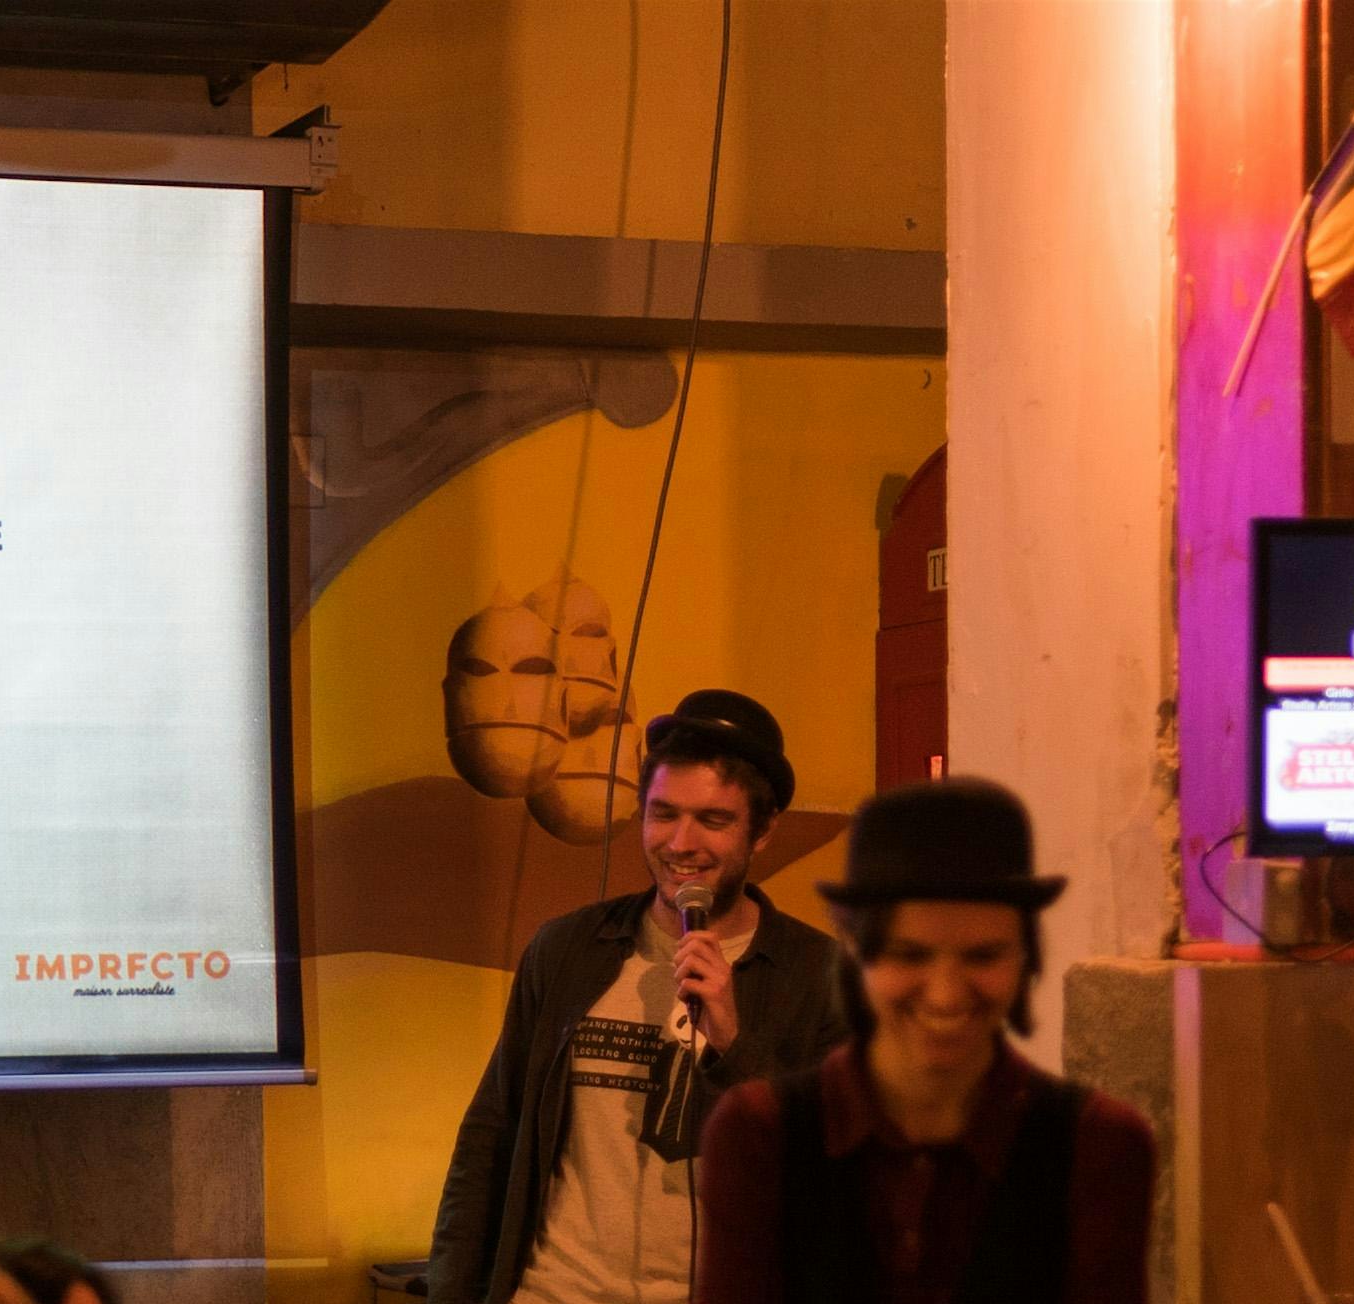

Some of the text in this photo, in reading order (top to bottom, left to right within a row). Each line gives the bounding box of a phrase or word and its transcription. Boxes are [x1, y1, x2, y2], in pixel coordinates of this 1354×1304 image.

[15, 950, 232, 982] IMPRFCTO
[73, 984, 114, 998] maison
[612, 1036, 664, 1050] NOTHING
